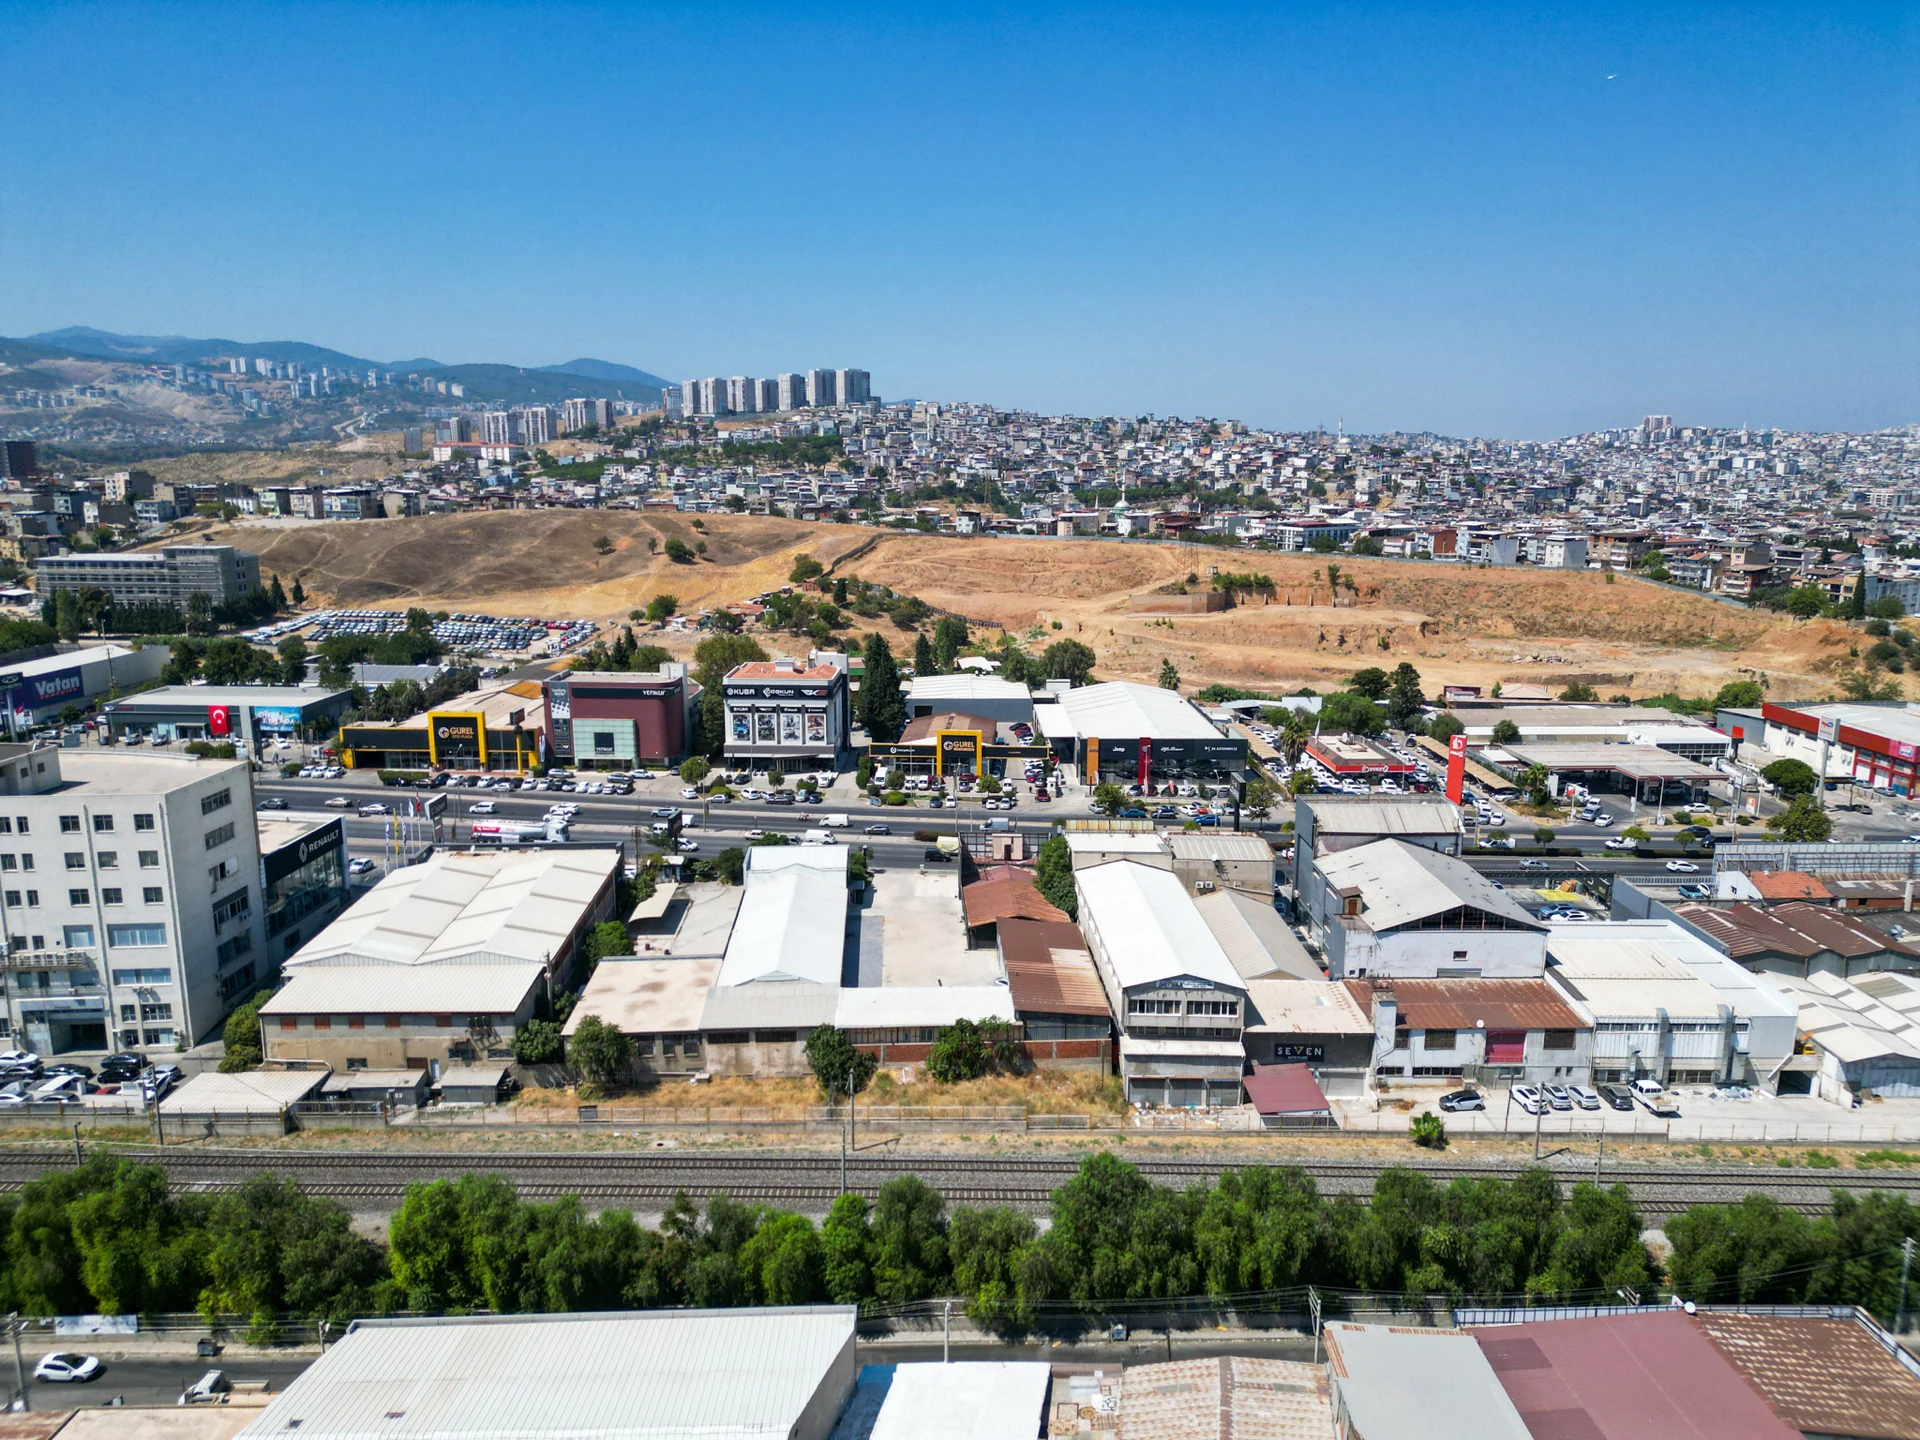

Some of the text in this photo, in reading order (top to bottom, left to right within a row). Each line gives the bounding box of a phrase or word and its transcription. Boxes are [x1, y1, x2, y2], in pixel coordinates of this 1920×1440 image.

[35, 676, 80, 695] Vatan
[308, 829, 339, 853] RENAULT
[1278, 1046, 1321, 1056] SEVEN
